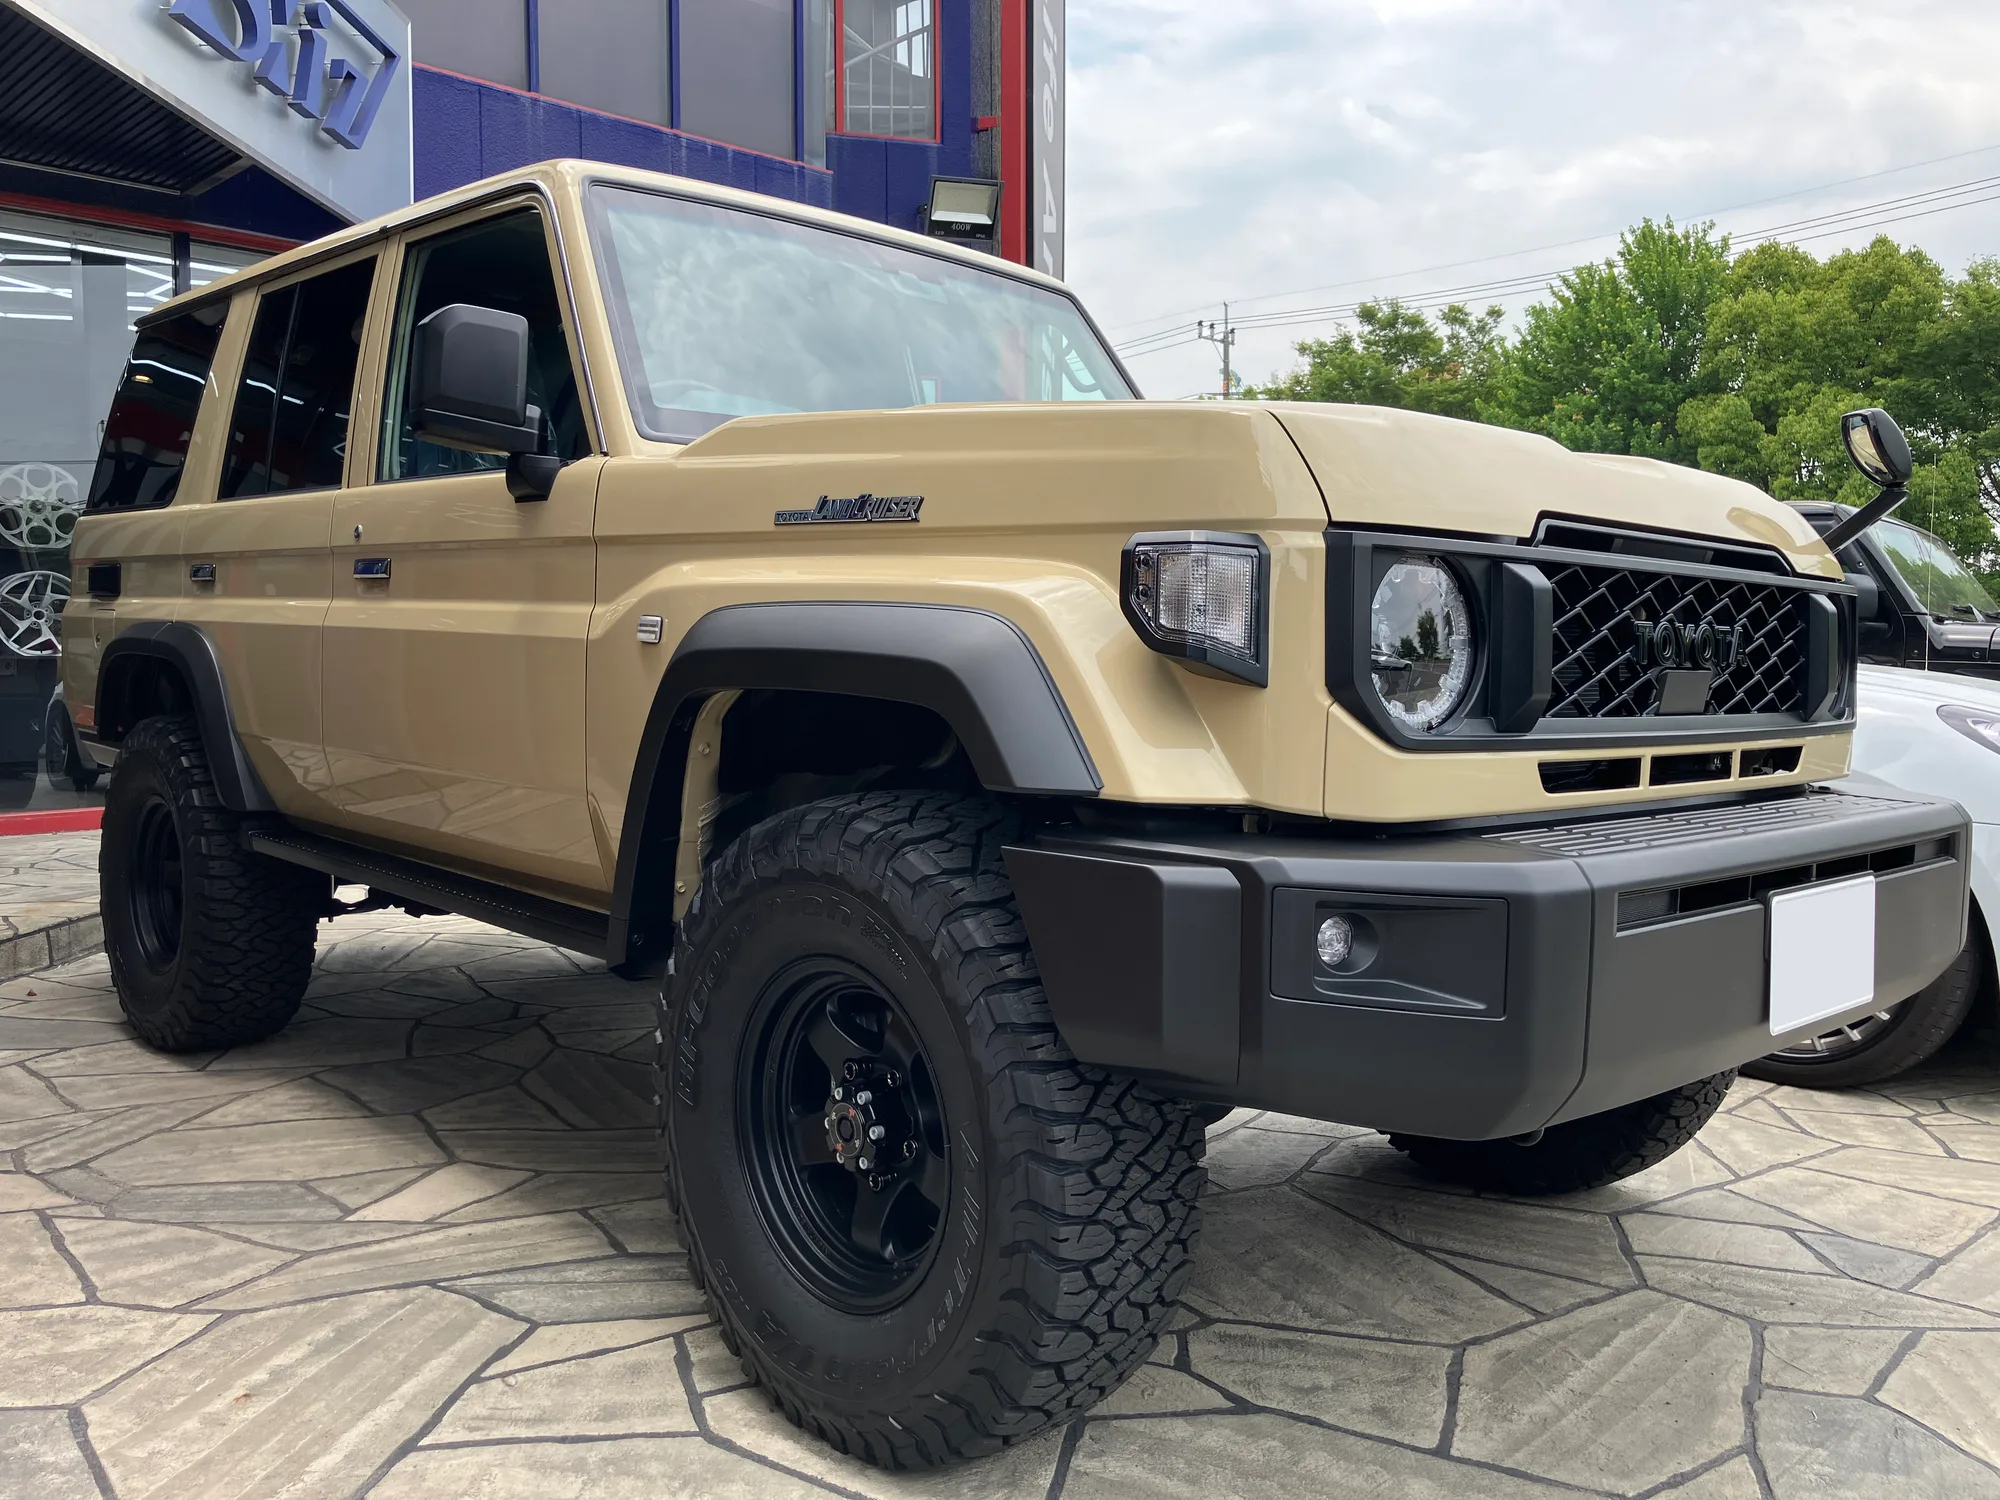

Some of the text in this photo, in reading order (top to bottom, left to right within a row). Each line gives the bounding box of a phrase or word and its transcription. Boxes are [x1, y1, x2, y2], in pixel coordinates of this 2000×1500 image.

[1042, 0, 1058, 143] ife
[951, 223, 972, 231] 400W
[776, 512, 809, 523] TOYOTA
[1633, 621, 1748, 668] TOYOTA
